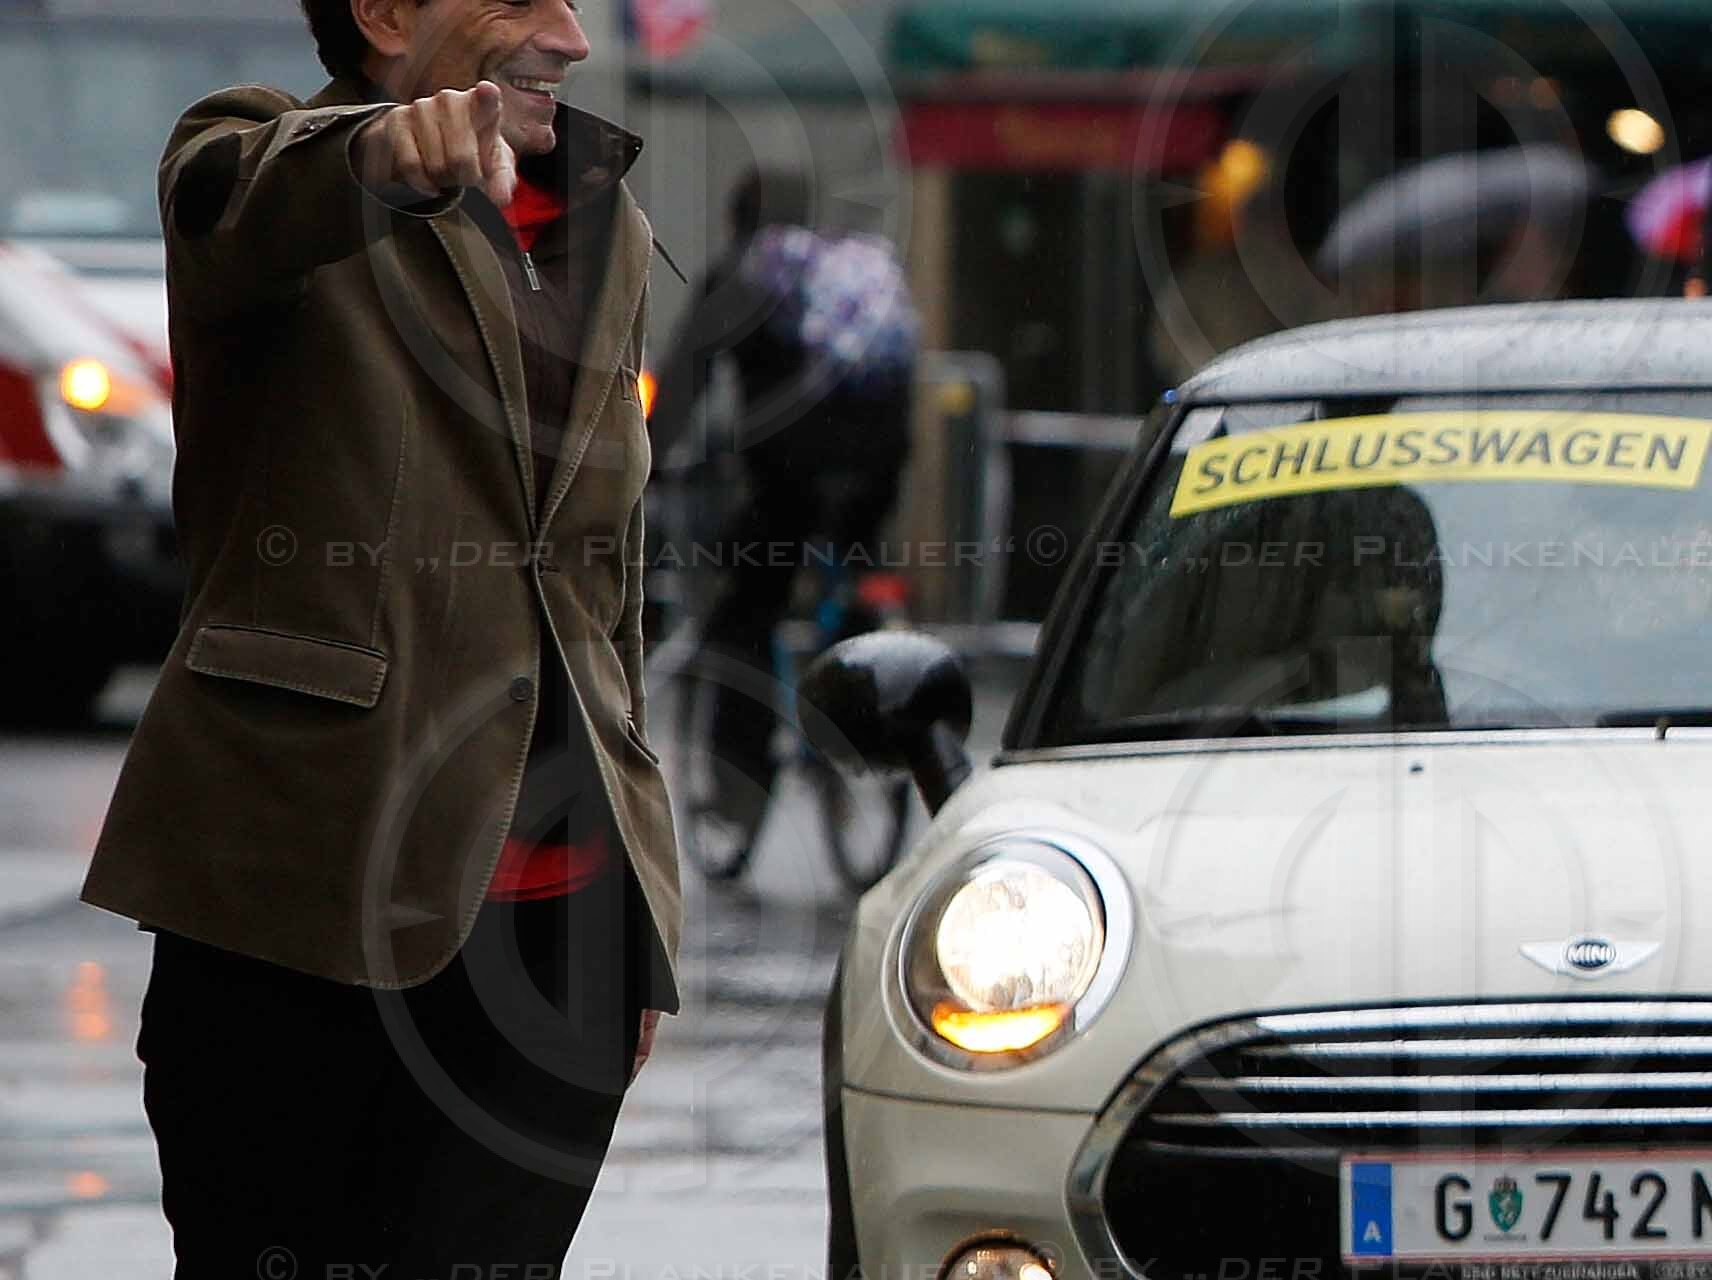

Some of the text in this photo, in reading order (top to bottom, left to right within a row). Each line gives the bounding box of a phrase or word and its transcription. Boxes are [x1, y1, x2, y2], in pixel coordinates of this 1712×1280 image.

[1192, 427, 1690, 495] SCHLUSSWAGEN
[1566, 943, 1615, 963] MINI
[1434, 1172, 1473, 1242] G
[1534, 1170, 1669, 1241] 742
[1363, 1219, 1383, 1242] A
